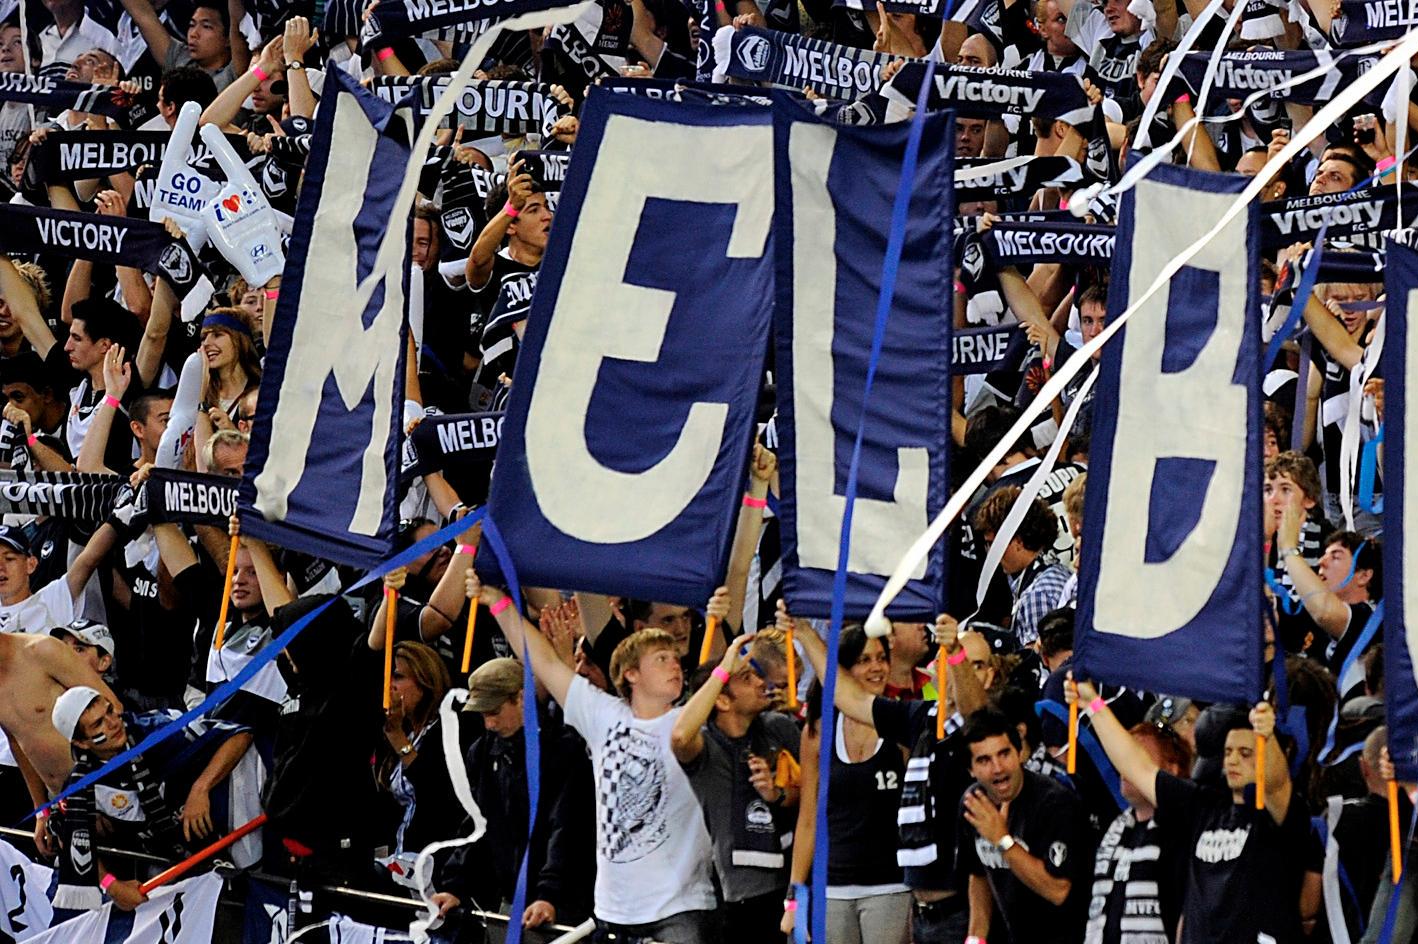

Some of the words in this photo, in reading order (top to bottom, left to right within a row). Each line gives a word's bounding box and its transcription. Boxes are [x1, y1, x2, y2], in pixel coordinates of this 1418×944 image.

[934, 75, 1046, 113] Victory
[171, 172, 201, 194] GO
[1286, 189, 1372, 210] MELBOURNE
[1270, 200, 1386, 236] Victory
[36, 217, 129, 254] VICTORY
[875, 770, 898, 790] 12
